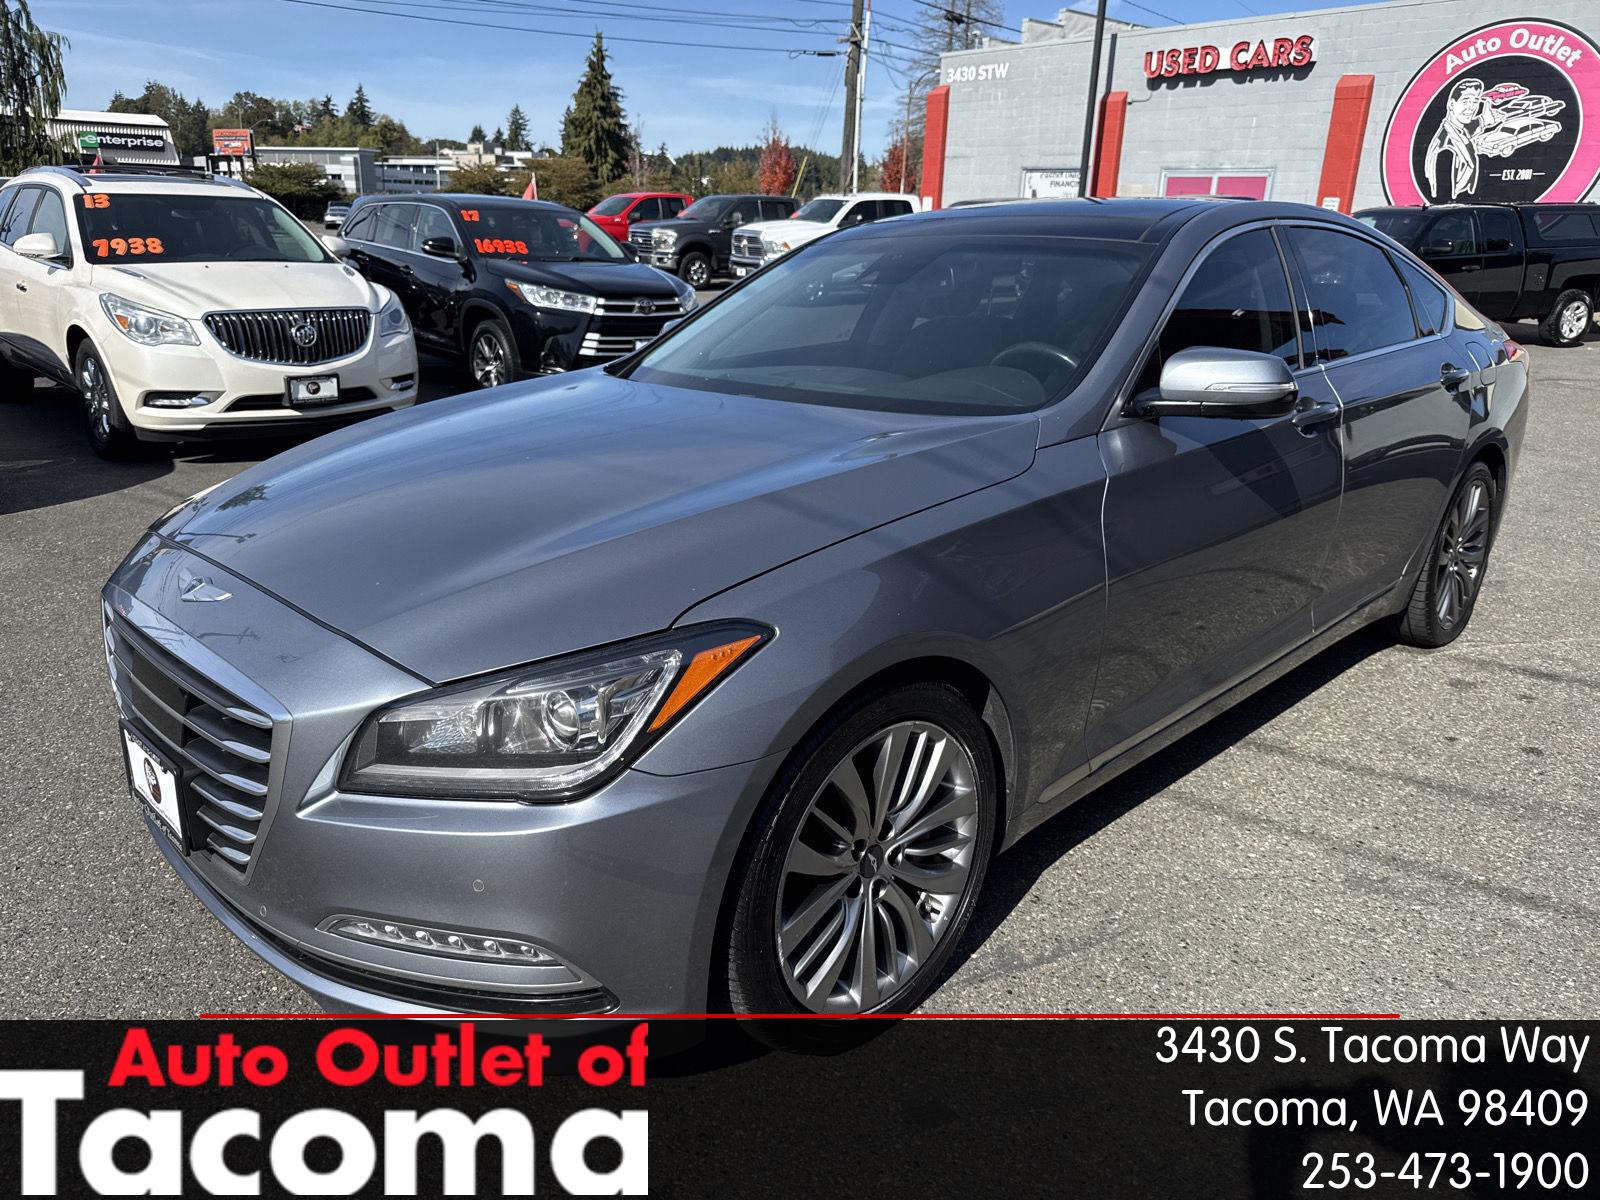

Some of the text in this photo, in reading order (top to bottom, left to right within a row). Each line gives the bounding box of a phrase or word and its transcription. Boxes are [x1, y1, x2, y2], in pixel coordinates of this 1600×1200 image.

[1143, 34, 1314, 79] USED CARS
[1445, 27, 1583, 75] Auto Outlet
[946, 62, 1010, 83] 3430 STW
[79, 134, 164, 148] enterprise
[83, 194, 111, 209] 13
[461, 209, 480, 222] 17
[92, 237, 164, 257] 7938
[474, 238, 529, 255] 16938
